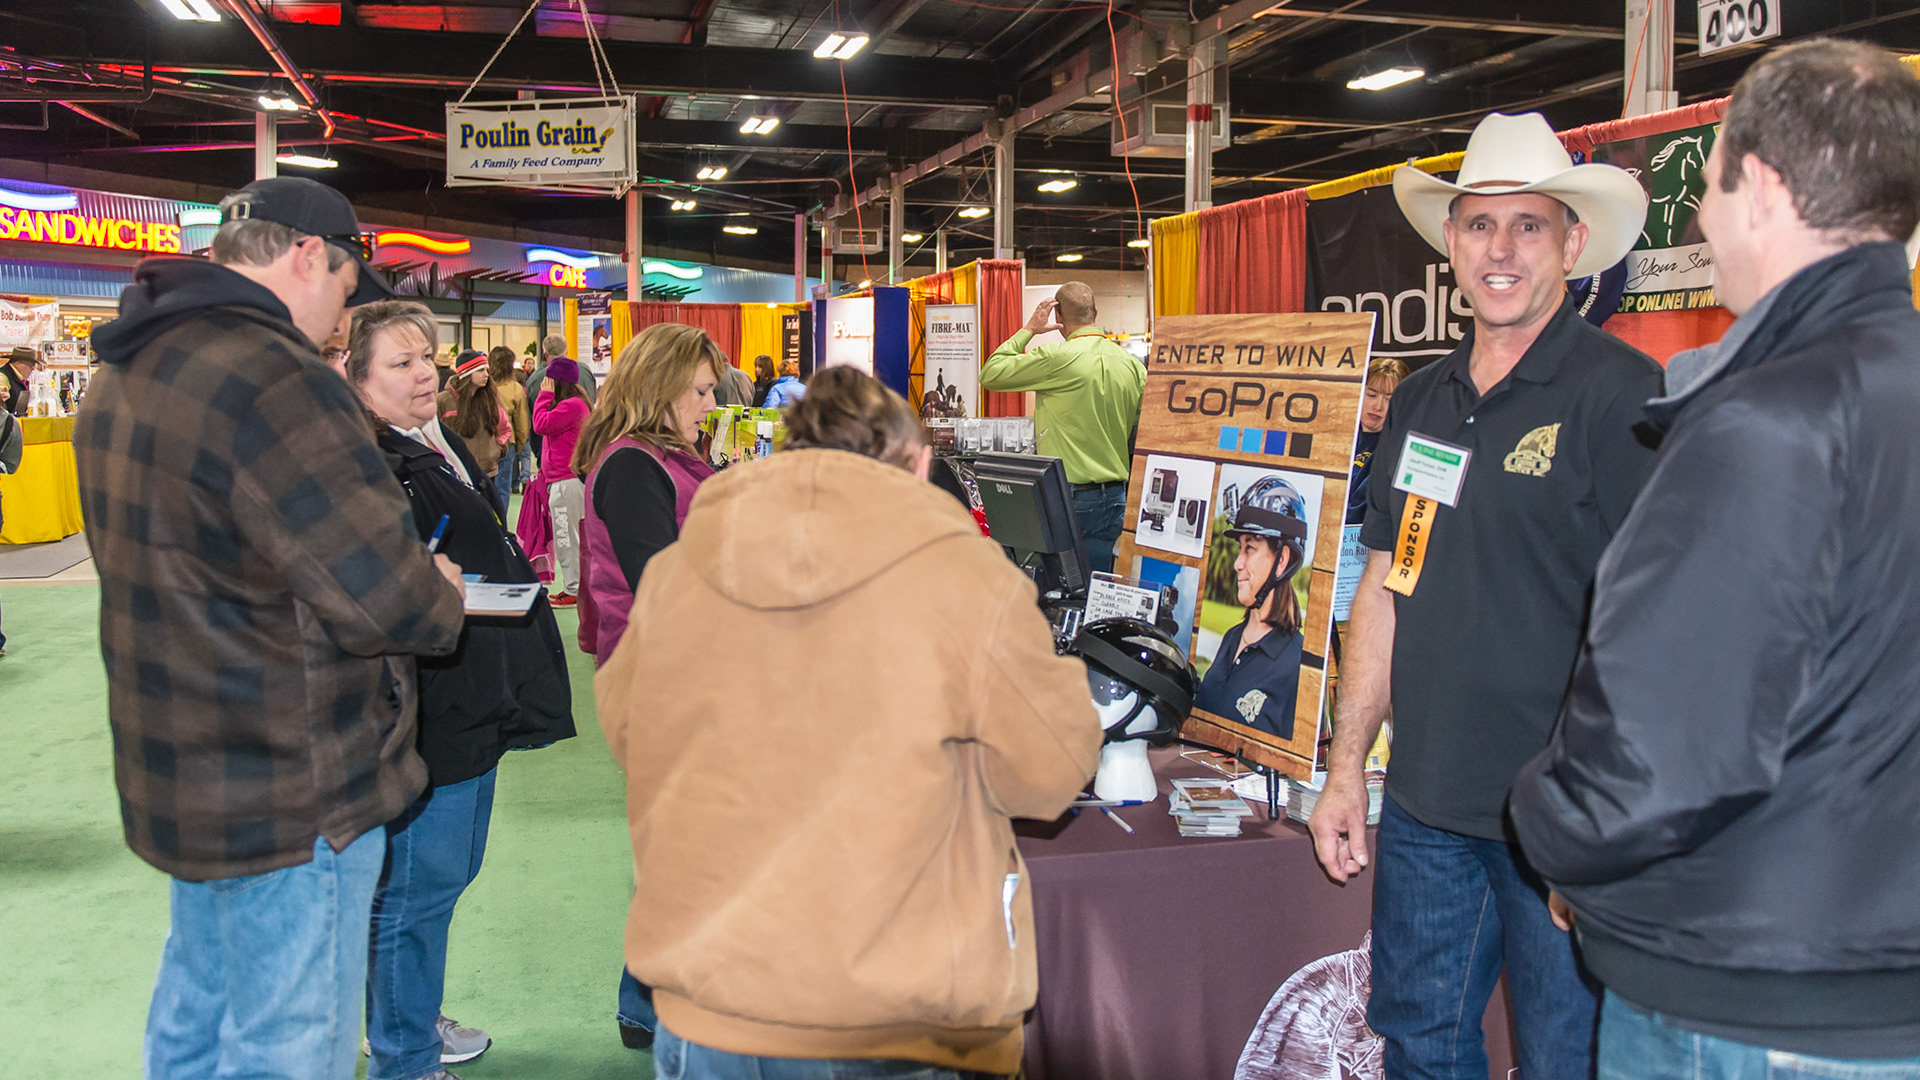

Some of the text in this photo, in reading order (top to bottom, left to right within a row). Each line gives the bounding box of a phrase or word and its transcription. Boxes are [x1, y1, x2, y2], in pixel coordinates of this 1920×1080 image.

[1706, 0, 1768, 47] 400
[460, 117, 599, 149] Poulin Grain
[470, 156, 605, 169] A Family Feed Company
[0, 206, 182, 254] SANDWICHES
[549, 264, 587, 289] CAFE
[1626, 247, 1715, 290] Your Sou
[1636, 292, 1685, 312] ONLINE!
[931, 322, 971, 333] FIBRE-MAX
[1156, 344, 1356, 369] ENTER TO WIN A
[1167, 379, 1319, 423] GoPro
[996, 483, 1013, 494] DELL
[1350, 532, 1361, 543] Af
[1399, 499, 1427, 579] SPONSOR
